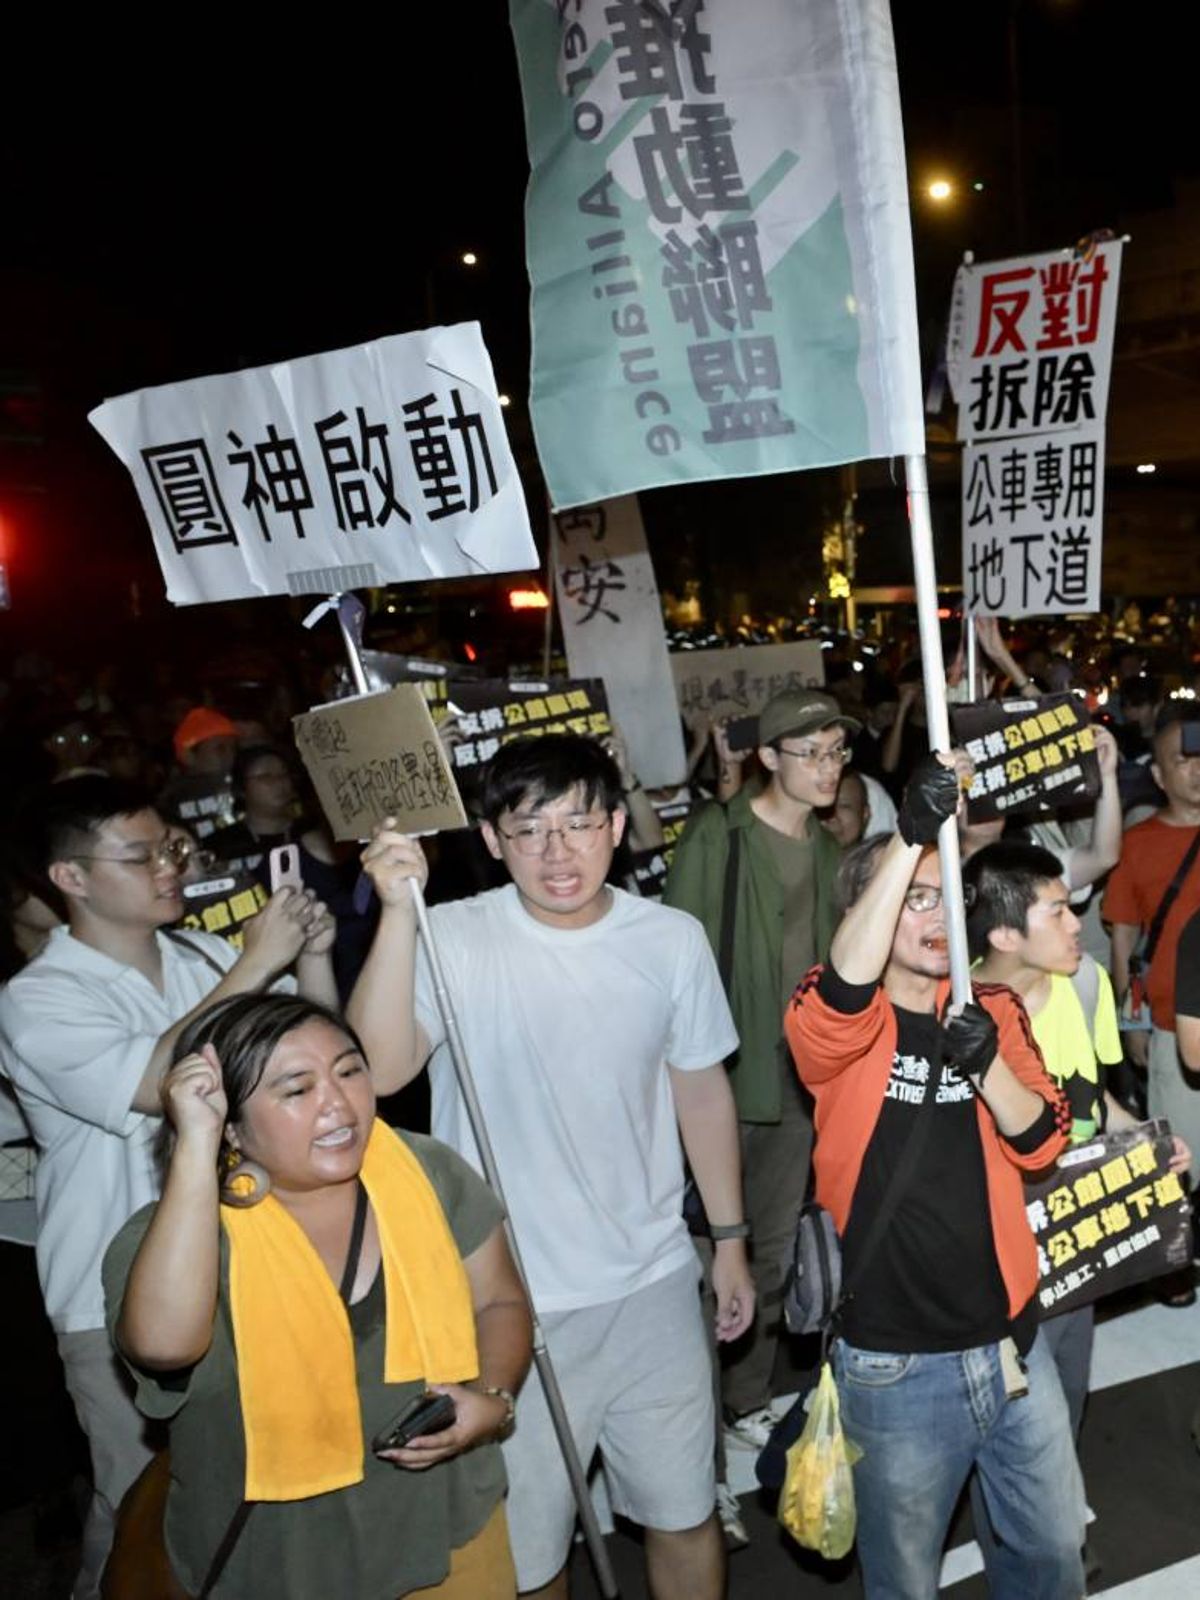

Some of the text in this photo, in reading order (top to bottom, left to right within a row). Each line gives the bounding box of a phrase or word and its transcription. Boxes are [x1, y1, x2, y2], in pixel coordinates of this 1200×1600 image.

[971, 254, 1109, 358] 反對
[969, 352, 1096, 432] 拆除
[141, 388, 500, 555] 圓神啟動
[966, 441, 1098, 528] 公車專用
[968, 525, 1091, 611] 地下道
